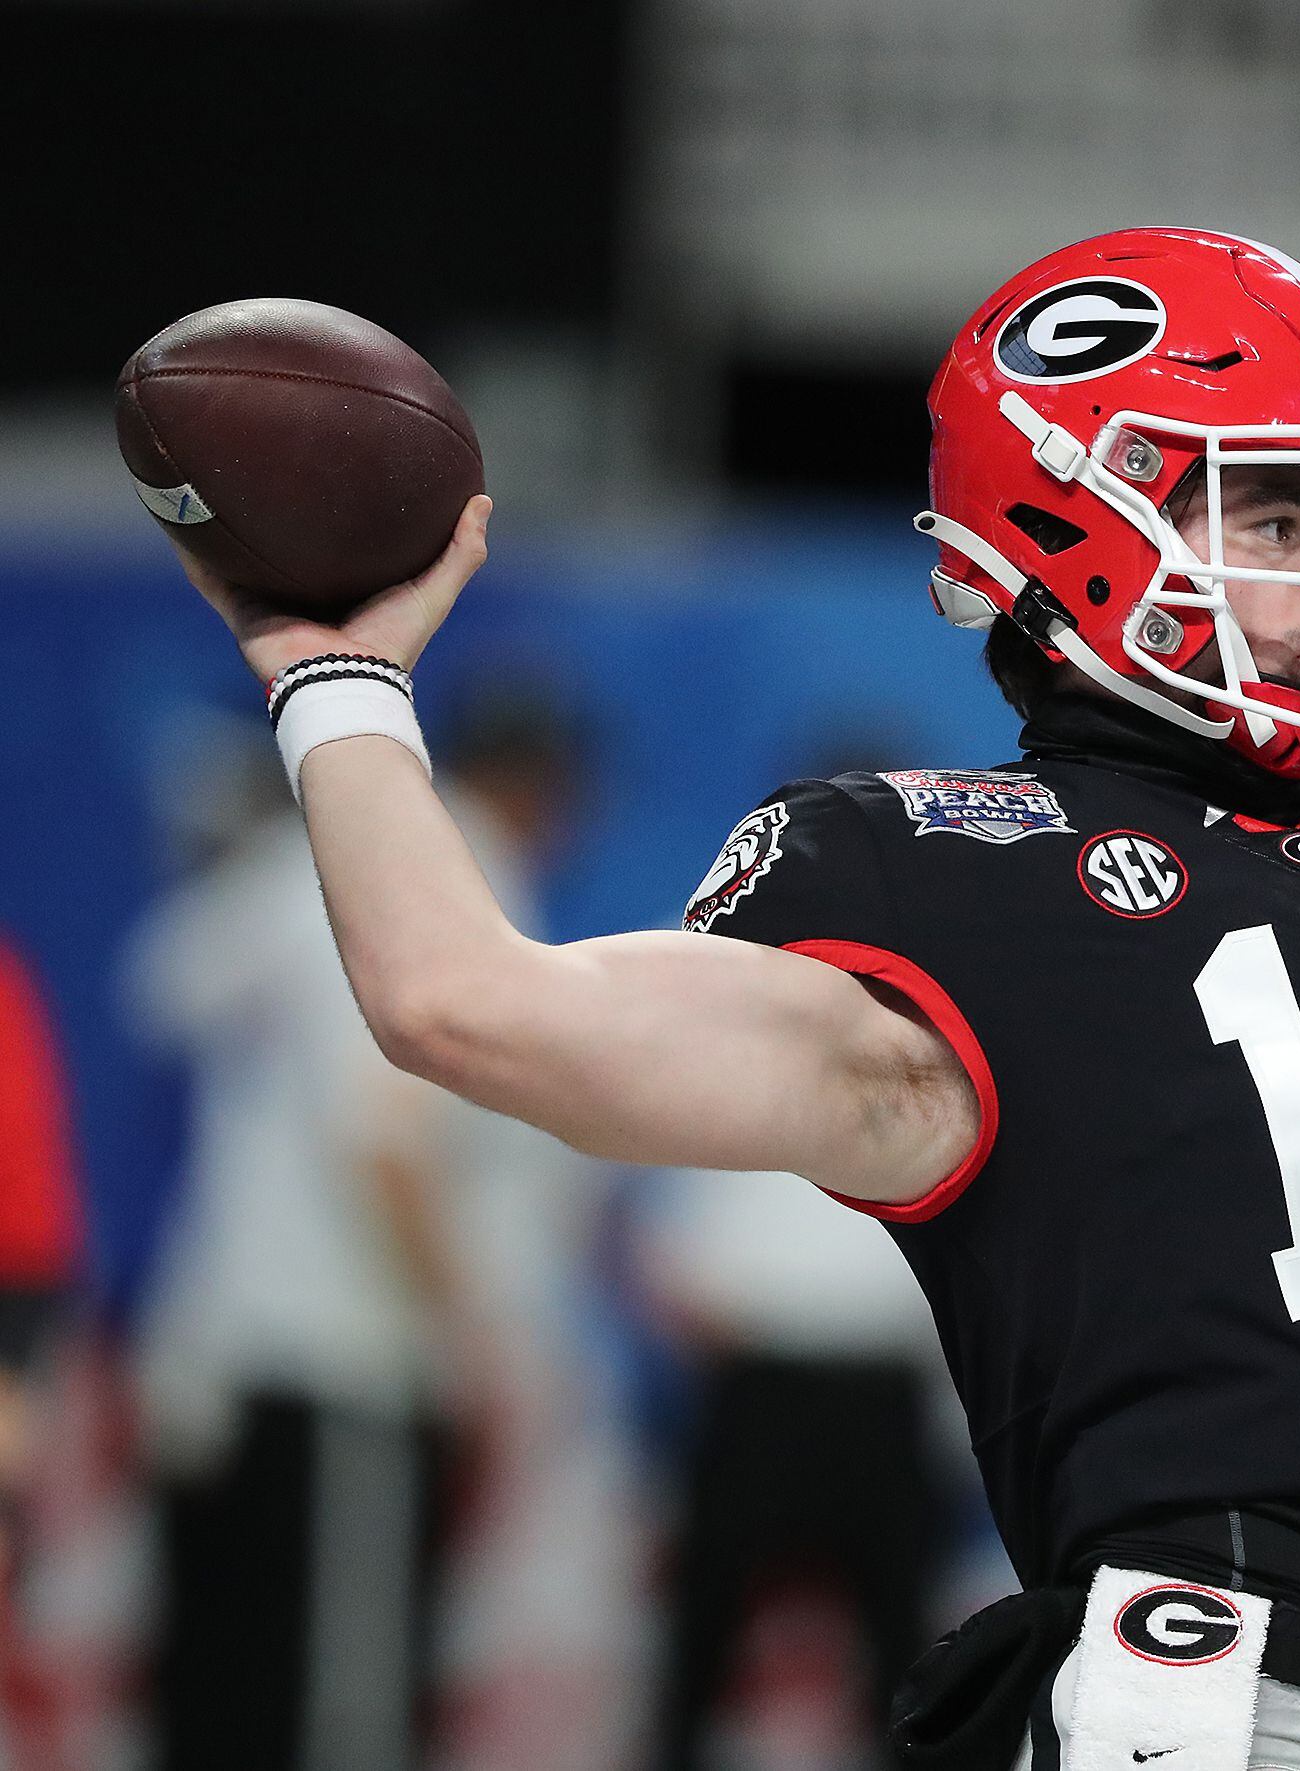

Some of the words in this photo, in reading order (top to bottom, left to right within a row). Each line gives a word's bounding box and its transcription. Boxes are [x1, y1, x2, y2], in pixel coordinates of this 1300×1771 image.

[997, 279, 1161, 378] G
[904, 788, 1060, 815] PEACH
[944, 809, 1033, 821] BOWL
[1087, 837, 1178, 911] SEC
[1119, 1589, 1240, 1660] G
